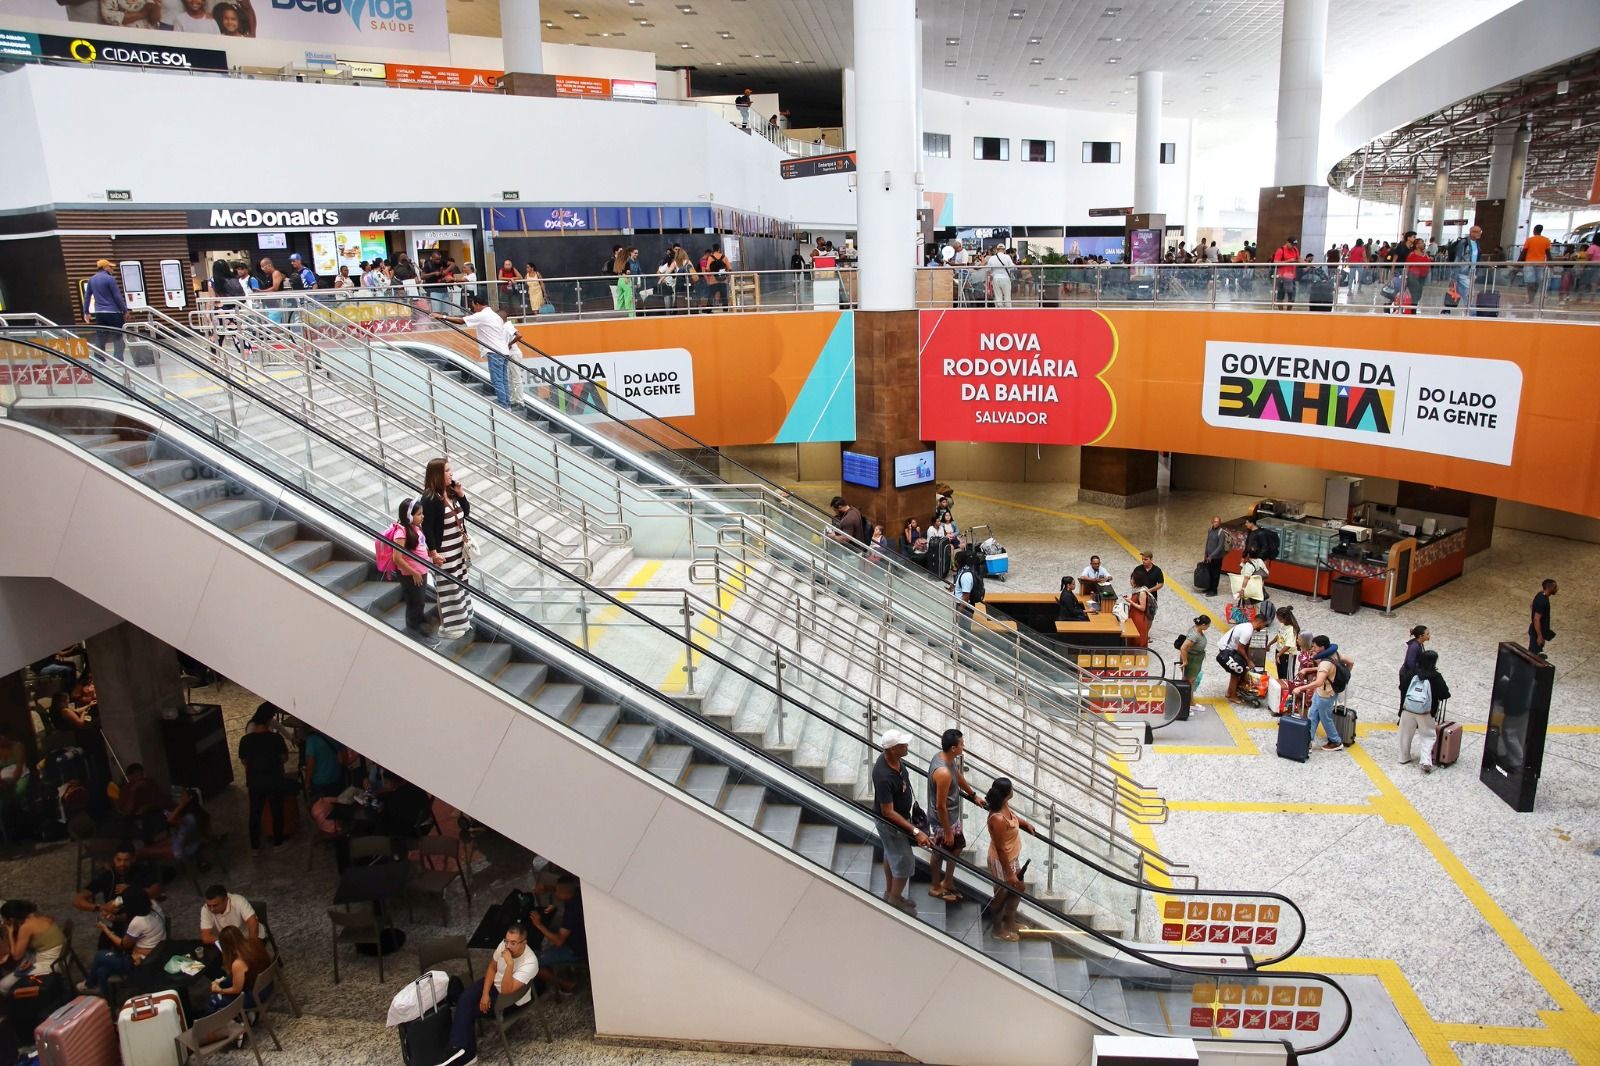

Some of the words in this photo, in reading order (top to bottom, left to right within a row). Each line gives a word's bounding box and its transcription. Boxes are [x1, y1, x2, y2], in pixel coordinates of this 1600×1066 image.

[371, 20, 415, 33] SAÚDE
[102, 47, 160, 64] CIDADE
[161, 52, 191, 67] SOL
[210, 208, 338, 227] McDonald's
[369, 209, 399, 223] McCafé
[980, 332, 1041, 351] NOVA
[578, 362, 606, 380] DA
[943, 354, 1078, 377] RODOVIÁRIA
[1221, 353, 1350, 382] GOVERNO
[1358, 362, 1395, 387] DA
[624, 373, 642, 385] DO
[645, 371, 677, 383] LADO
[624, 387, 641, 398] DA
[643, 384, 680, 396] GENTE
[961, 383, 990, 401] DA
[995, 384, 1059, 403] BAHIA
[1418, 387, 1445, 402] DO
[1448, 390, 1496, 409] LADO
[1218, 375, 1392, 434] BAHIA
[975, 411, 1047, 425] SALVADOR
[1416, 405, 1440, 421] DA
[1443, 409, 1497, 429] GENTE
